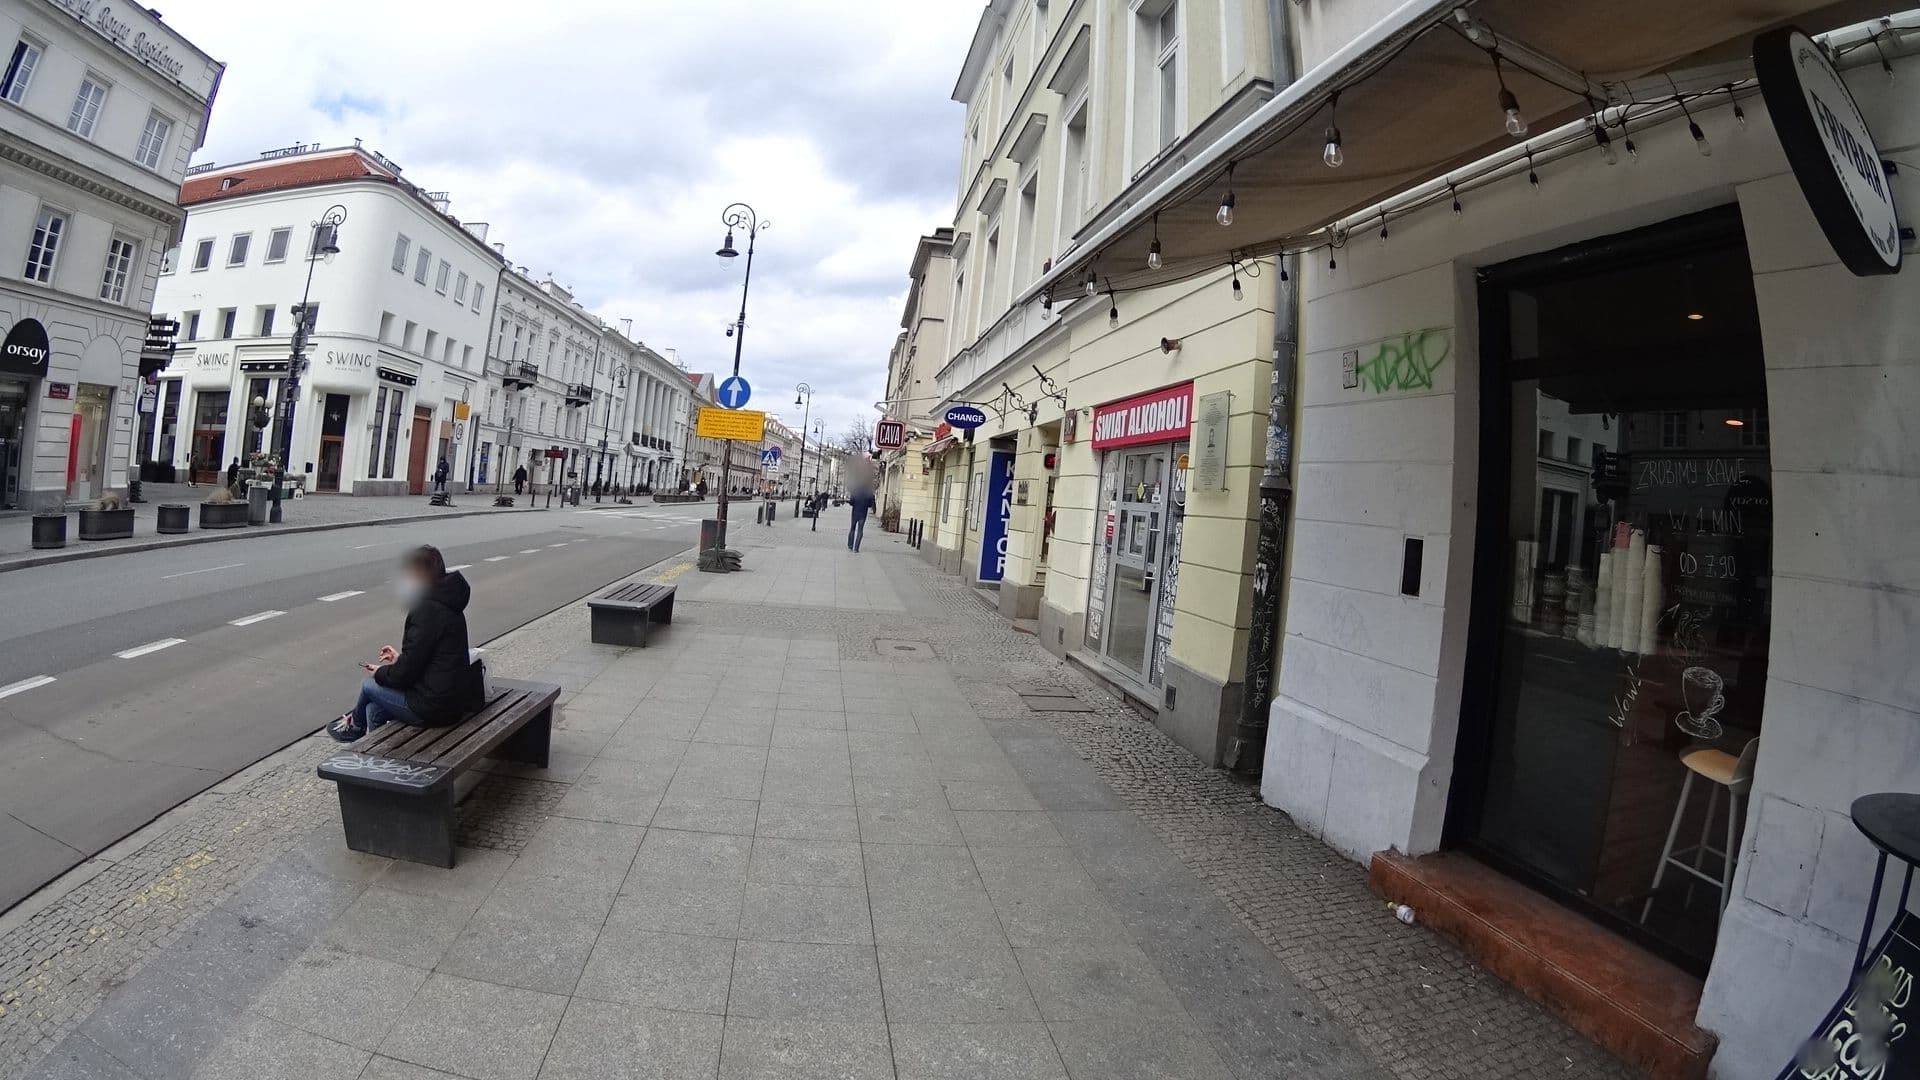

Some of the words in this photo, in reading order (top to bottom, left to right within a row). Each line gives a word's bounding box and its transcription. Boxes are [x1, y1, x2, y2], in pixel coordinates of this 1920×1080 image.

[7, 343, 47, 365] orsay
[197, 353, 229, 367] SWING
[327, 351, 372, 368] SWING
[947, 412, 984, 424] CHANGE
[1095, 409, 1129, 442] ŚWIAT
[1127, 395, 1189, 437] ALKOHOLI
[880, 424, 900, 445] CAVA
[1638, 459, 1698, 486] ZROBIMY
[1679, 551, 1698, 575] OD
